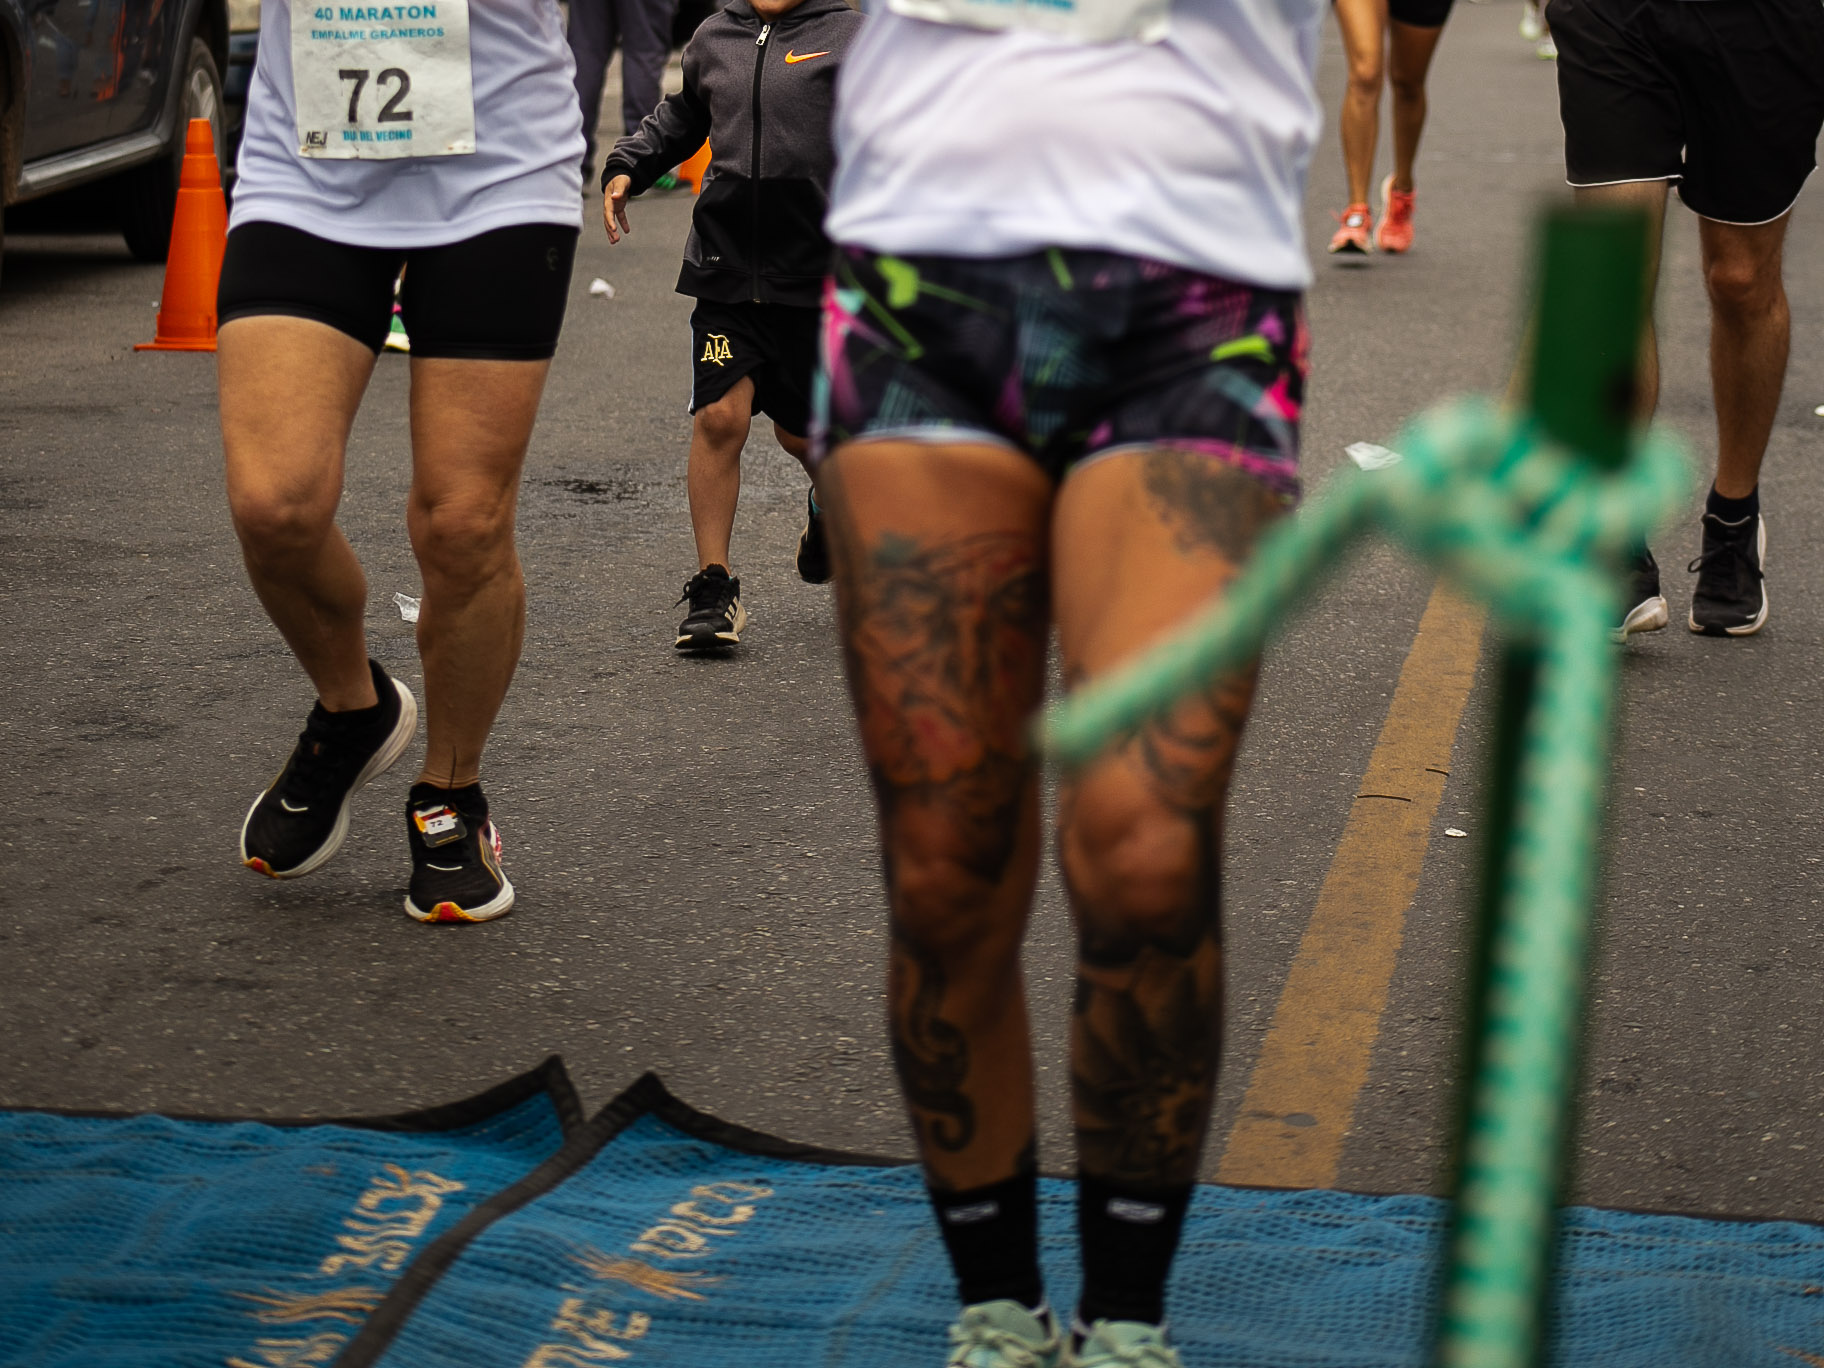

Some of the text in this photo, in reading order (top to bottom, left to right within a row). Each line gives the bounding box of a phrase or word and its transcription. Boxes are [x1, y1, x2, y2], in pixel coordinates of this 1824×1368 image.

[314, 5, 437, 21] 40 MARATON
[311, 28, 445, 40] EMPALME GRANEROS
[338, 67, 414, 123] 72
[306, 131, 328, 145] NEJ
[375, 129, 413, 142] VECINO
[430, 819, 444, 828] 72
